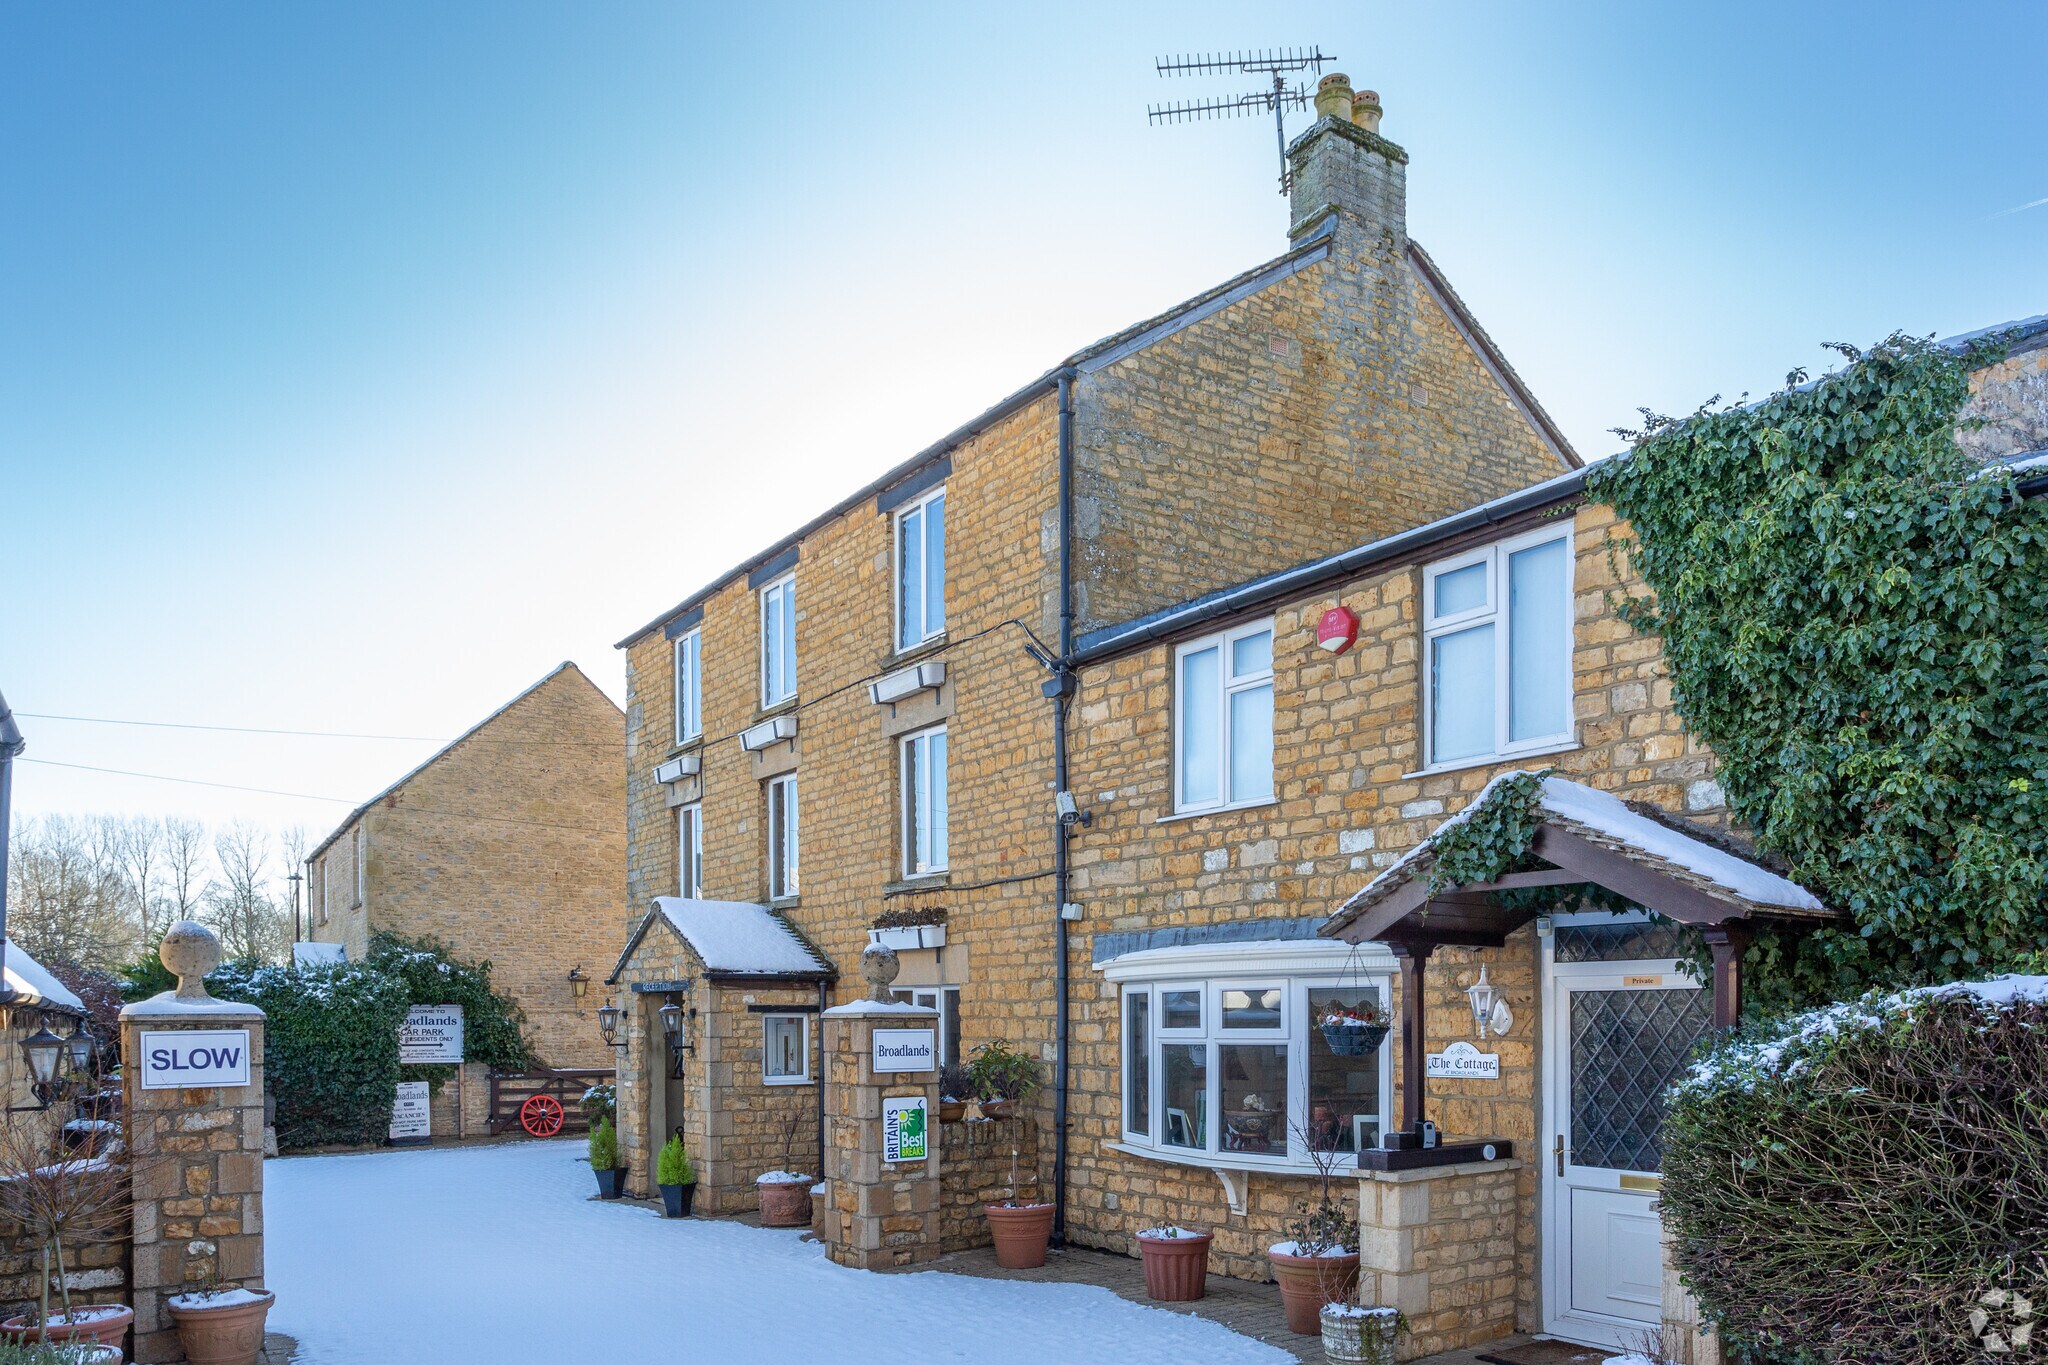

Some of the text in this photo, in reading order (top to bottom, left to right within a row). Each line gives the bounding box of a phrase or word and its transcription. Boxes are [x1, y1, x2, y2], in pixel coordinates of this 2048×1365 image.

[642, 982, 672, 991] RECEPTION
[403, 1015, 458, 1026] oadlands
[400, 1028, 444, 1036] CAR PARK
[878, 1044, 930, 1057] Broadlands
[151, 1047, 241, 1071] SLOW
[1431, 1057, 1494, 1071] The Cottage
[398, 1090, 429, 1100] oadlands
[887, 1109, 899, 1160] BRITAIN'S
[901, 1131, 923, 1148] Best
[901, 1146, 924, 1157] BREAKS
